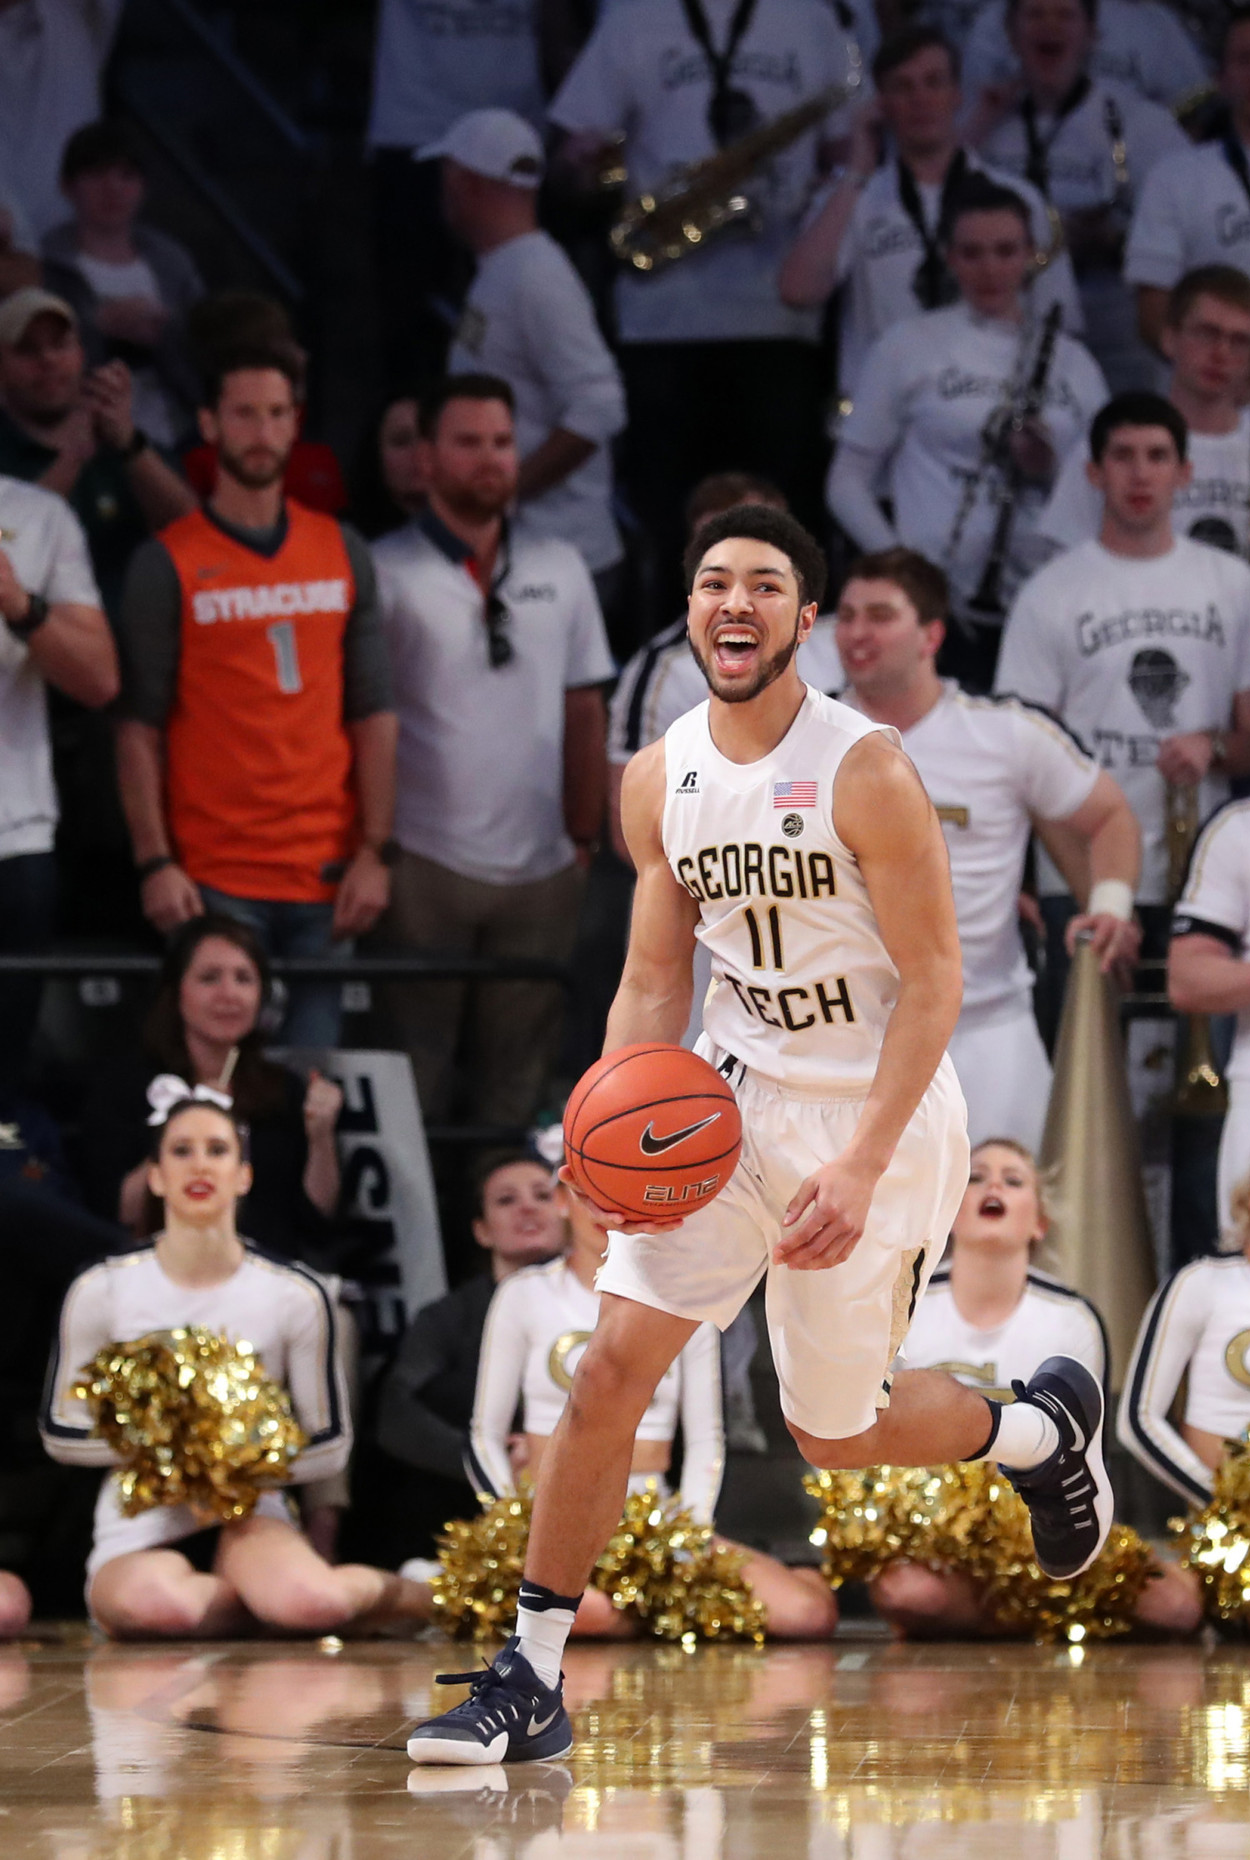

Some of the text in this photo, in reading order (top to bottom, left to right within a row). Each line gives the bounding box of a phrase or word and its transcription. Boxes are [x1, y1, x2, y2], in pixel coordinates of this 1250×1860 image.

[193, 577, 349, 626] SYRACUSE
[1076, 603, 1227, 658] GEORGIA
[266, 620, 303, 694] 1
[677, 843, 838, 903] GEORGIA
[741, 902, 786, 973] 11
[723, 973, 855, 1032] TECH
[643, 1173, 721, 1204] ELITE
